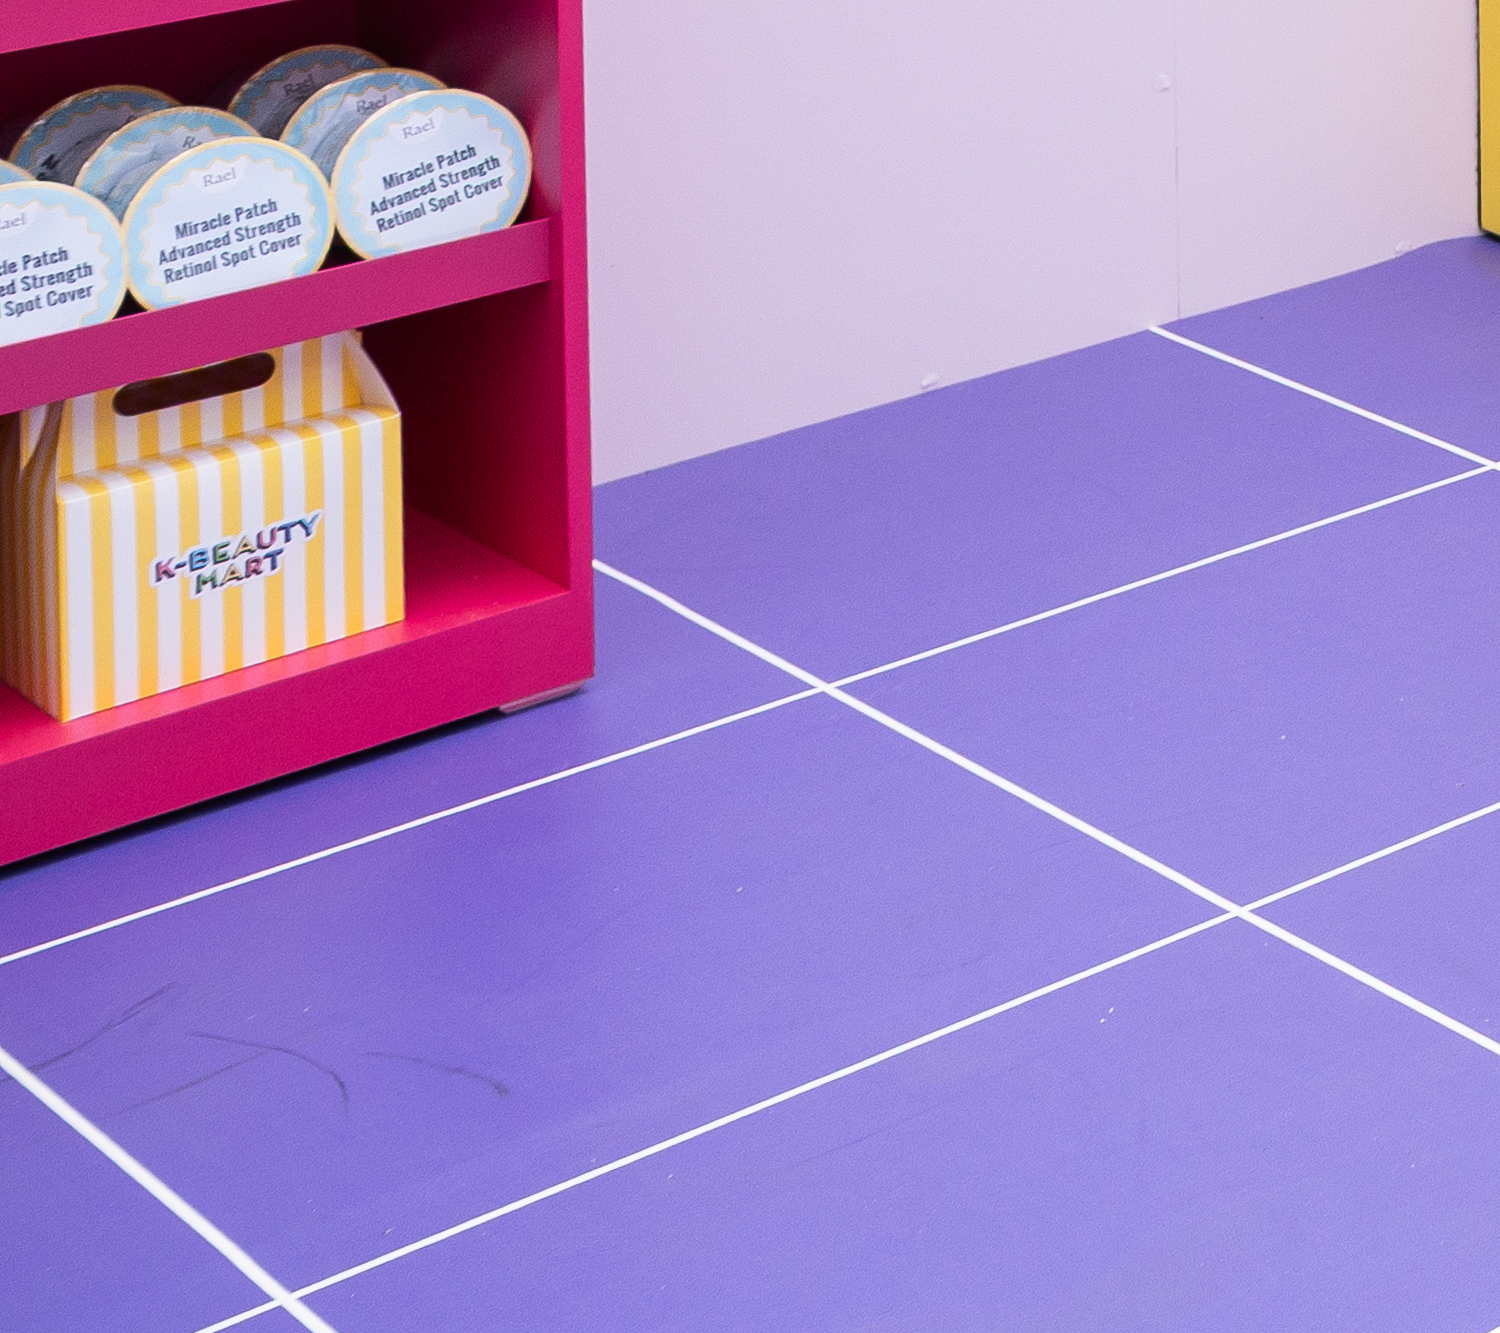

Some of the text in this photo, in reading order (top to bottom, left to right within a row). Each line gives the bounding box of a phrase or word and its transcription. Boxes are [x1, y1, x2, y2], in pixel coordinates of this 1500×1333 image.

[402, 118, 435, 139] Rael
[369, 155, 501, 217] Advanced Strength
[382, 143, 477, 190] Miracle Patch
[376, 175, 504, 233] Retinol Spot Cover
[154, 514, 321, 584] K-BEAUTY
[194, 548, 284, 595] MART
